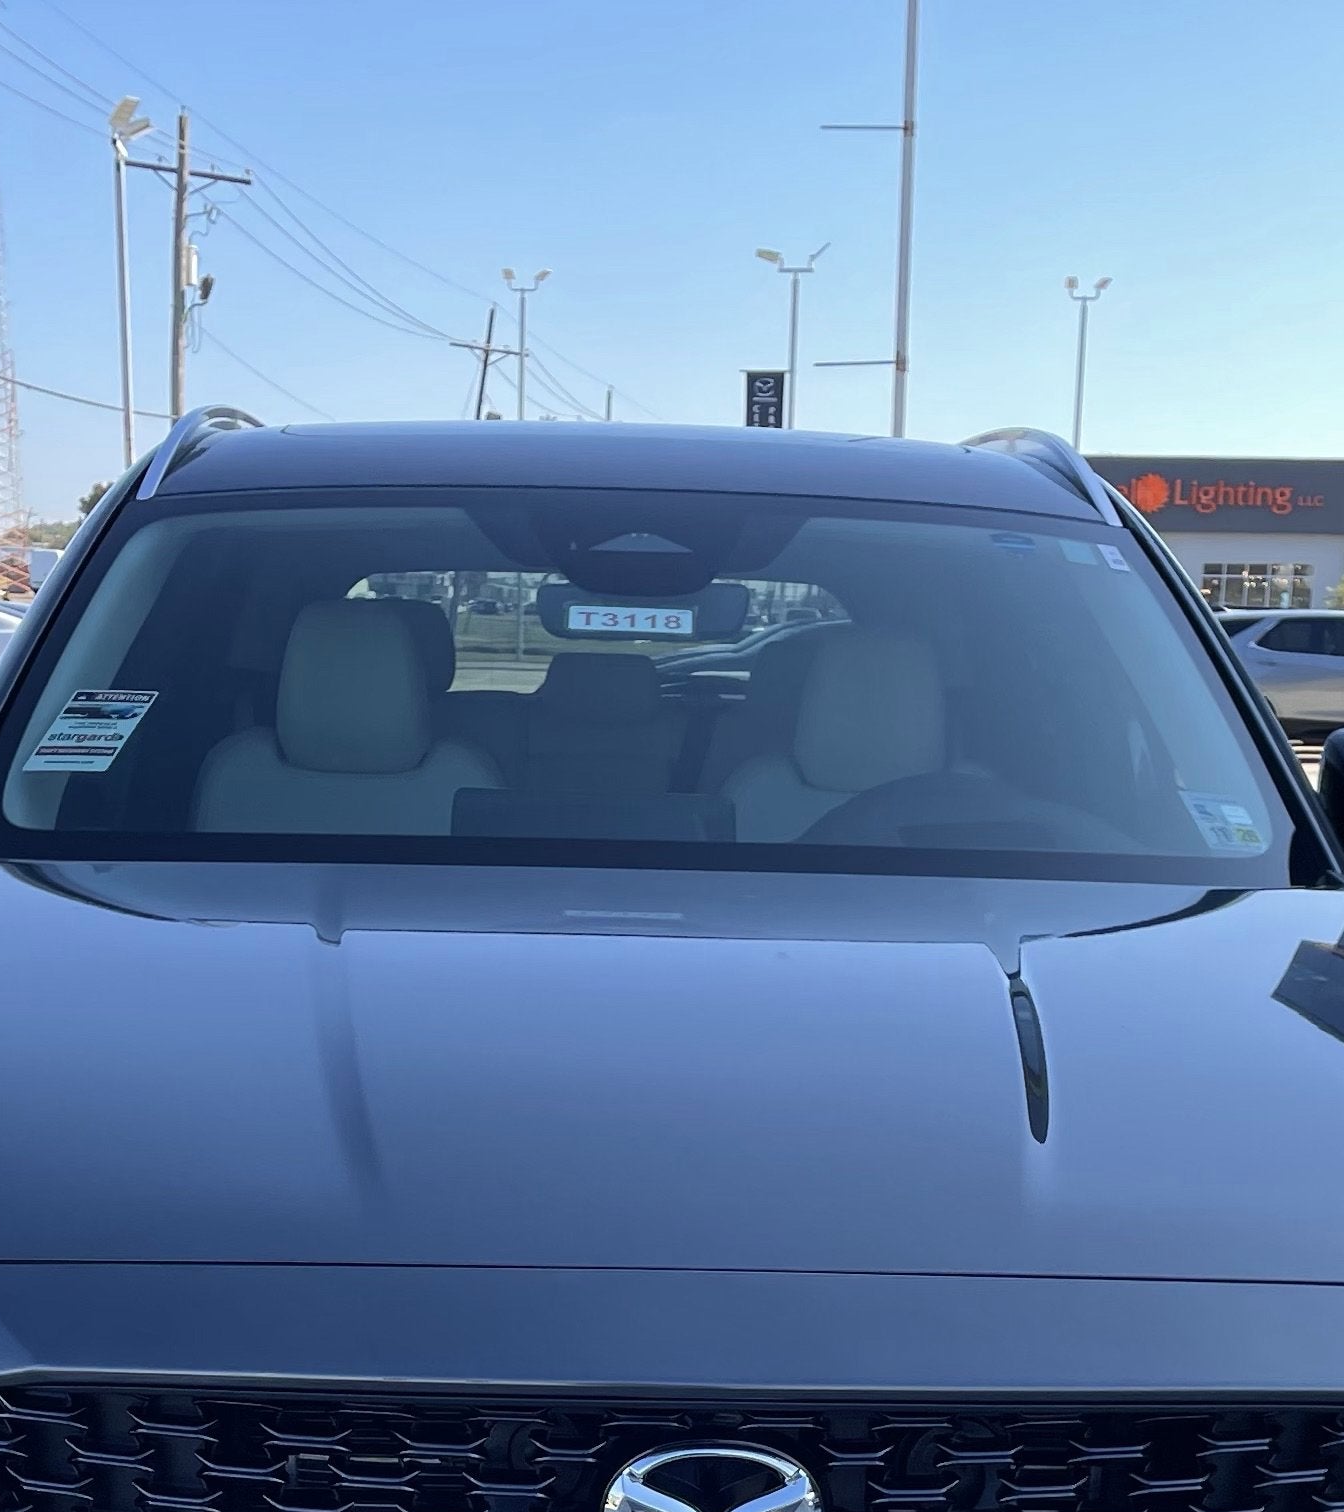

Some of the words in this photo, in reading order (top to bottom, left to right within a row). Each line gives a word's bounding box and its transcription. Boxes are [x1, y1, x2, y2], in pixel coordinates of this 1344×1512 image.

[1174, 479, 1294, 515] Lighting
[577, 611, 683, 630] T3118
[95, 693, 152, 702] ATTENTION
